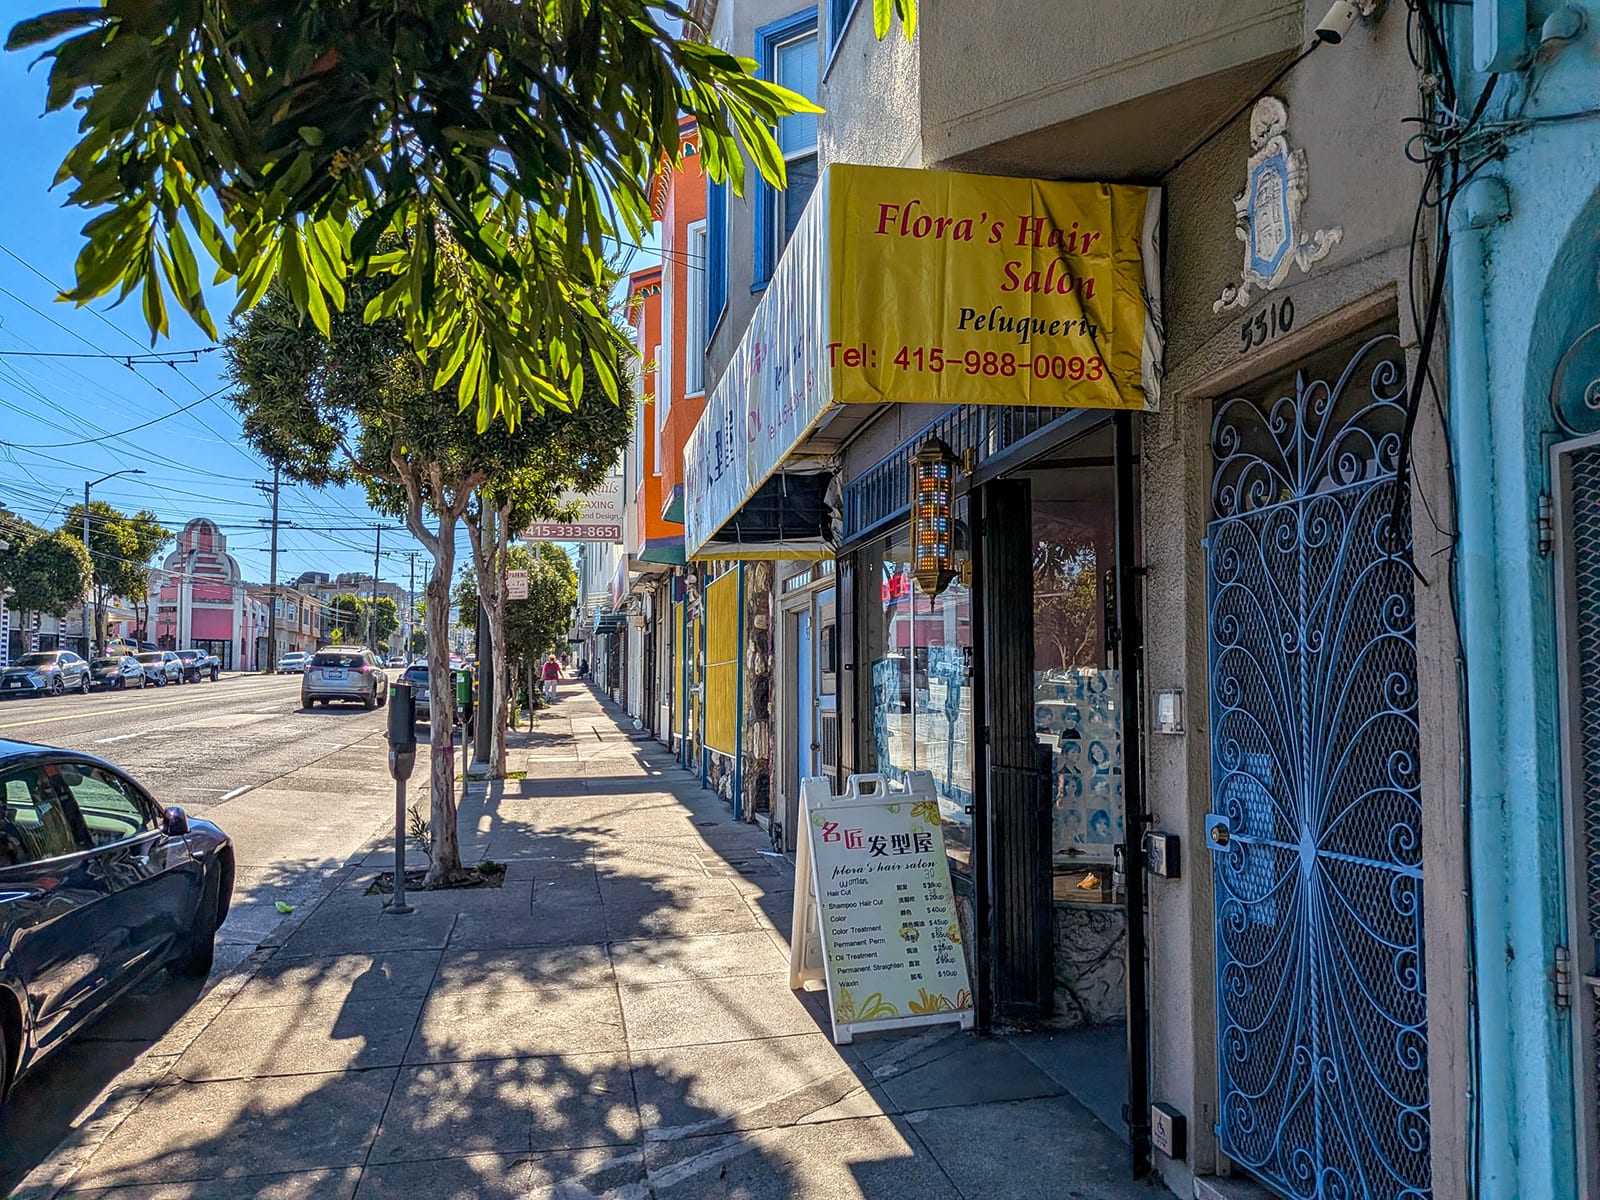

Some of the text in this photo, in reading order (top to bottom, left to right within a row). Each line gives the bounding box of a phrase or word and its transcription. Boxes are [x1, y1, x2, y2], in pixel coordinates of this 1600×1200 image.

[875, 200, 1101, 255] Flora's Hair
[1000, 256, 1096, 299] Salon
[1239, 296, 1294, 353] 5310
[826, 343, 877, 368] Tel:
[893, 346, 1104, 381] 415-988-0093
[585, 501, 614, 510] AXING
[595, 512, 619, 521] Design
[525, 526, 619, 537] 415-333-8651
[822, 821, 935, 857] 名匠发型屋
[877, 862, 902, 872] hair
[905, 858, 936, 868] salon
[828, 902, 857, 910] Shampoo
[850, 925, 882, 934] Treatment
[833, 939, 867, 948] Permanent
[847, 951, 878, 960] Treatment
[837, 965, 871, 974] Permanent
